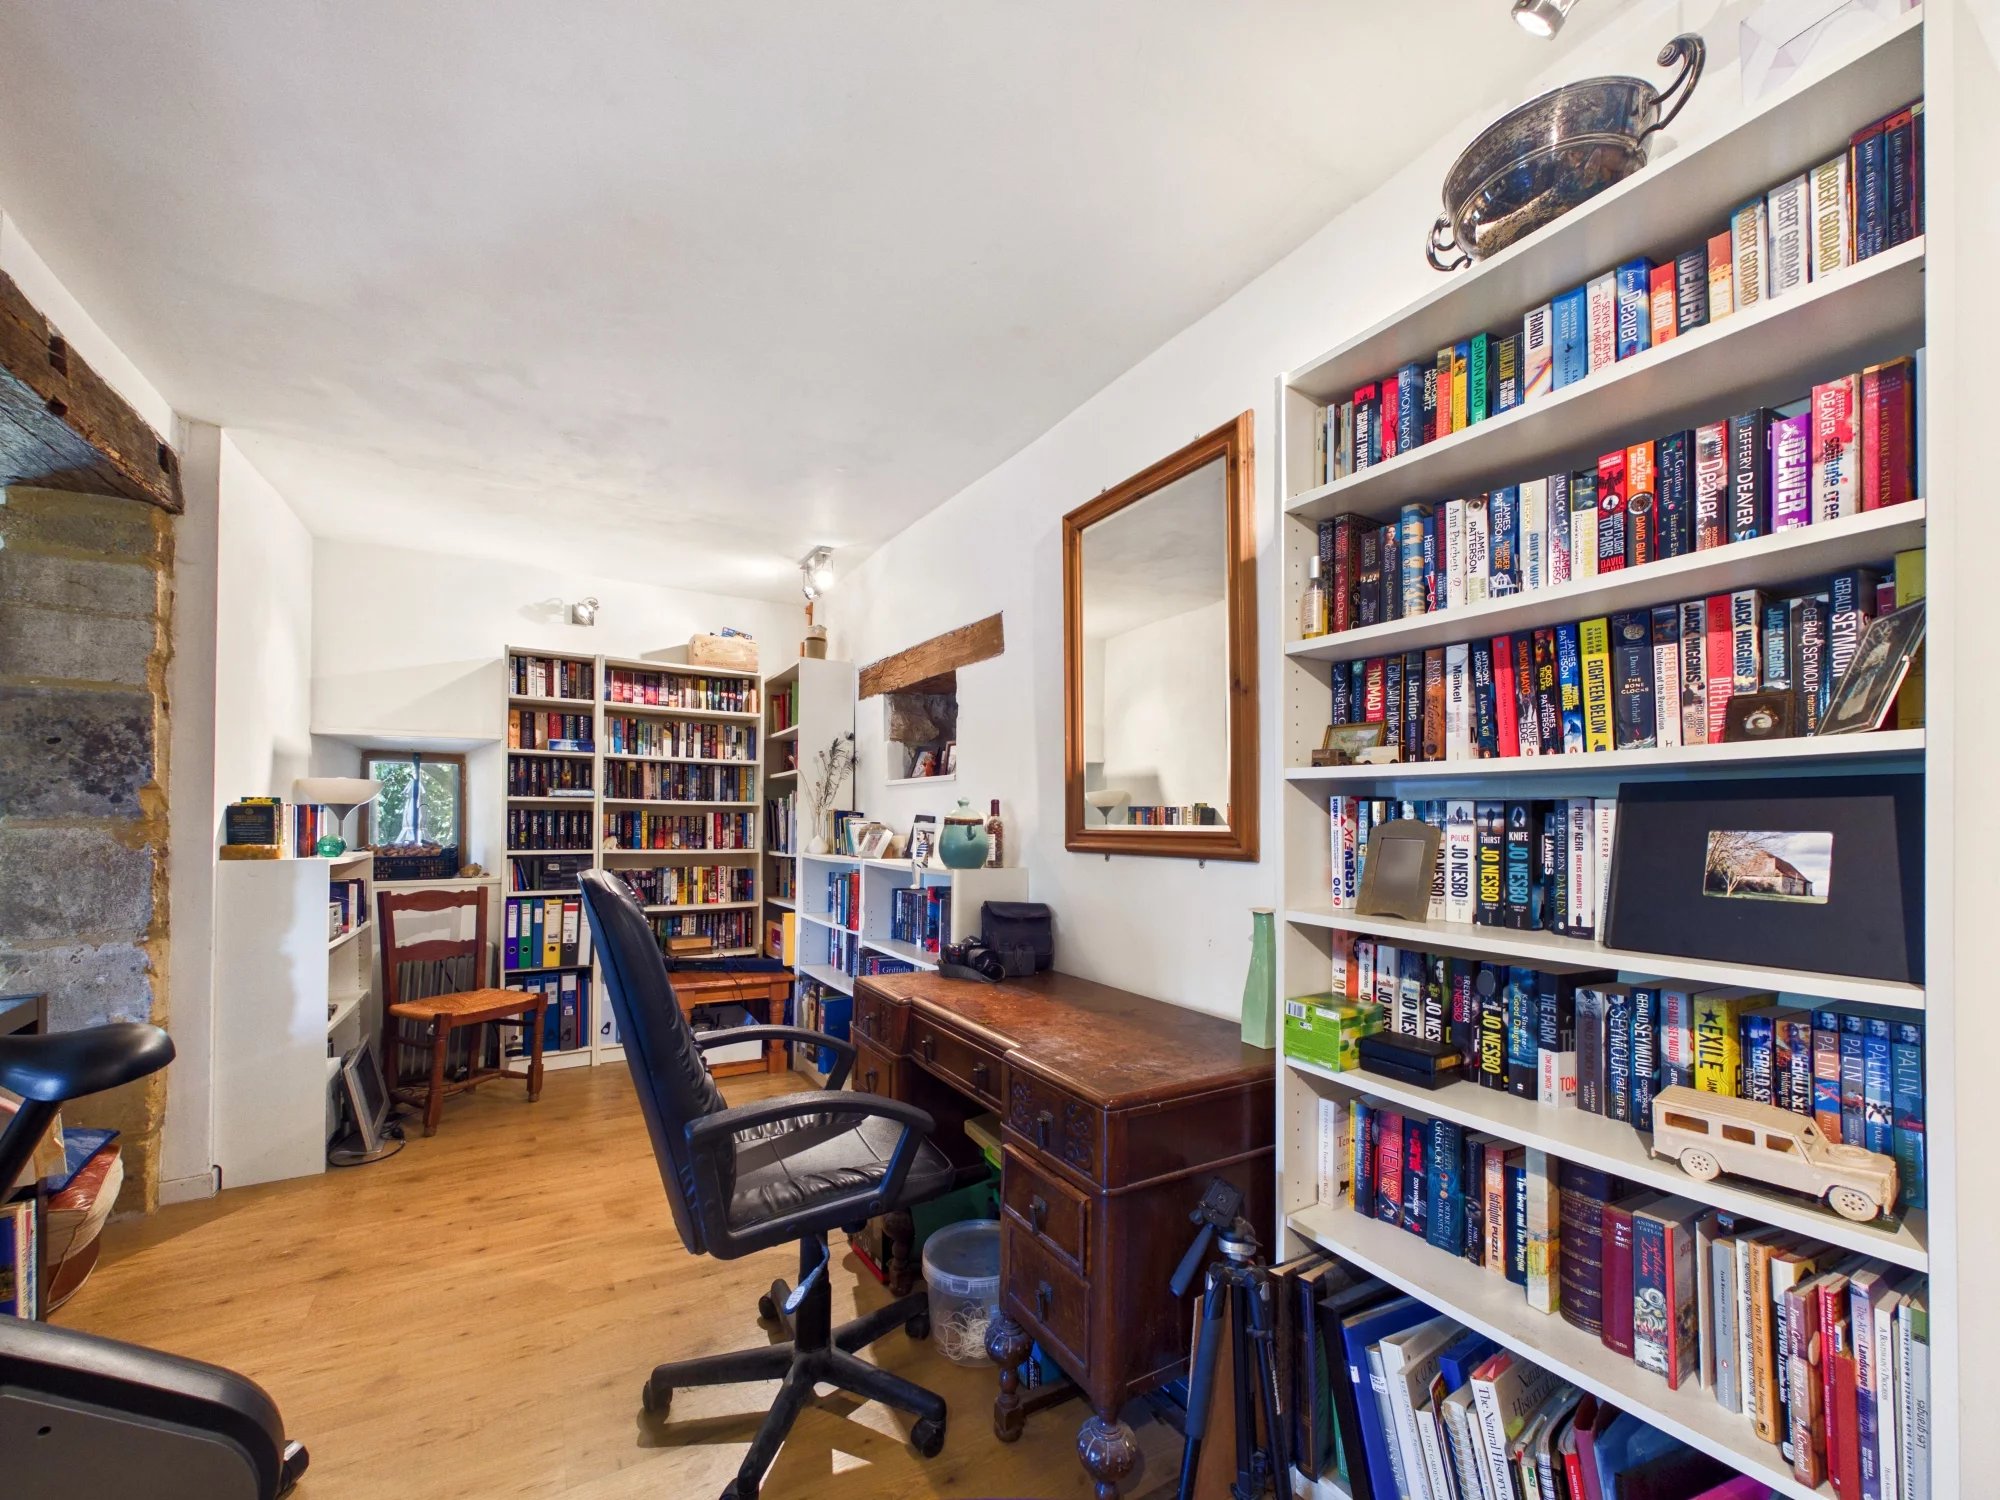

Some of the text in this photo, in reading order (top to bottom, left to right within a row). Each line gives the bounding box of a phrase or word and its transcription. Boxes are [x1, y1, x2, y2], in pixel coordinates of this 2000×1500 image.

[1778, 182, 1800, 288] ROBERT GODDARD
[1817, 160, 1841, 272] ROBERT GODDARD
[1733, 205, 1759, 305] ROBERT GODDARD
[1653, 291, 1673, 330] DEAVER
[1679, 260, 1705, 327] DEAVER
[1529, 311, 1544, 349] FRANZEN
[1602, 300, 1610, 363] SEVEN DEATHS
[1473, 340, 1484, 407] SIMON MAYO
[1401, 378, 1411, 449] SIMON MAYO
[1820, 390, 1835, 436] DEAVER
[1836, 391, 1845, 421] JEFFERY
[1736, 427, 1754, 527] JEFFERY DEAVER
[1778, 438, 1807, 516] DEAVER
[1494, 492, 1502, 543] PATTERSON
[1502, 502, 1510, 531] JAMES
[1599, 516, 1614, 558] TO PARIS
[1614, 512, 1624, 555] NIGHT FLIGHT
[1404, 558, 1410, 570] OF
[1424, 534, 1433, 563] Harris
[1469, 521, 1477, 574] PATTERSON
[1494, 546, 1502, 569] HOUSE
[1502, 540, 1510, 570] MURDER
[1684, 605, 1702, 683] JACK HIGGINS
[1734, 596, 1753, 677] JACK HIGGINS
[1767, 608, 1785, 679] JACK HIGGINS
[1832, 577, 1857, 677] GERALD SEYMOUR
[1475, 651, 1483, 687] HOROWITZ
[1481, 651, 1489, 685] ANTHONY
[1518, 640, 1531, 695] SIMON MAYO
[1559, 630, 1569, 679] PATTERSON
[1568, 639, 1576, 667] JAMES
[1630, 656, 1639, 676] David
[1656, 647, 1664, 674] Children
[1803, 607, 1818, 693] GERALD SEYMOUR
[1367, 672, 1381, 710] NOMAD
[1432, 660, 1441, 687] RORY
[1452, 665, 1462, 703] Mankell
[1664, 645, 1677, 718] PETER ROBINSON
[1336, 683, 1347, 714] Night
[1408, 680, 1419, 721] Jardine
[1540, 694, 1549, 739] PATTERSON
[1548, 704, 1556, 728] JAMES
[1561, 683, 1574, 711] ROGUE
[1587, 659, 1606, 734] EIGHTEEN BELOW
[1631, 694, 1640, 723] Mitchell
[1657, 696, 1665, 730] Revolution
[1481, 716, 1488, 724] To
[1520, 723, 1529, 744] EDGE
[1528, 721, 1537, 746] KNIFE
[1359, 808, 1367, 840] NIGEL
[1450, 834, 1470, 842] POLICE
[1480, 836, 1501, 844] THIRST
[1508, 831, 1529, 842] KNIFE
[1574, 806, 1584, 851] PHILIP KERR
[1344, 828, 1355, 898] SCREWFIX
[1480, 846, 1499, 861] JO
[1508, 843, 1528, 860] JO
[1544, 838, 1554, 875] JAMES
[1601, 837, 1609, 858] KERR
[1451, 844, 1469, 898] JO NESBO
[1481, 864, 1500, 902] NESBO
[1508, 862, 1528, 904] NESBO
[1556, 873, 1566, 915] DARIEN
[1377, 988, 1392, 1003] JO
[1463, 979, 1471, 1023] REDEEMER
[1540, 993, 1556, 1044] THE FARM
[1634, 993, 1653, 1078] GERALD SEYMOUR
[1667, 995, 1679, 1063] GERALD SEYMOUR
[1482, 1011, 1501, 1074] JO NESBO
[1610, 1008, 1629, 1077] SEYMOUR
[1698, 1023, 1724, 1073] EXILE
[1817, 1035, 1836, 1079] PALIN
[1843, 1037, 1862, 1082] PALIN
[1867, 1043, 1888, 1089] PALIN
[1897, 1048, 1918, 1096] PALIN
[1615, 1076, 1625, 1106] rat run
[1780, 1071, 1791, 1107] Holding the
[1382, 1146, 1399, 1179] TEN
[1434, 1121, 1444, 1173] GREGORY
[1381, 1177, 1390, 1195] ROSE
[1389, 1179, 1398, 1202] KAREN
[1487, 1192, 1502, 1226] Istanbul
[1478, 1386, 1508, 1491] The Natural History
[1915, 1399, 1928, 1449] Les granges
